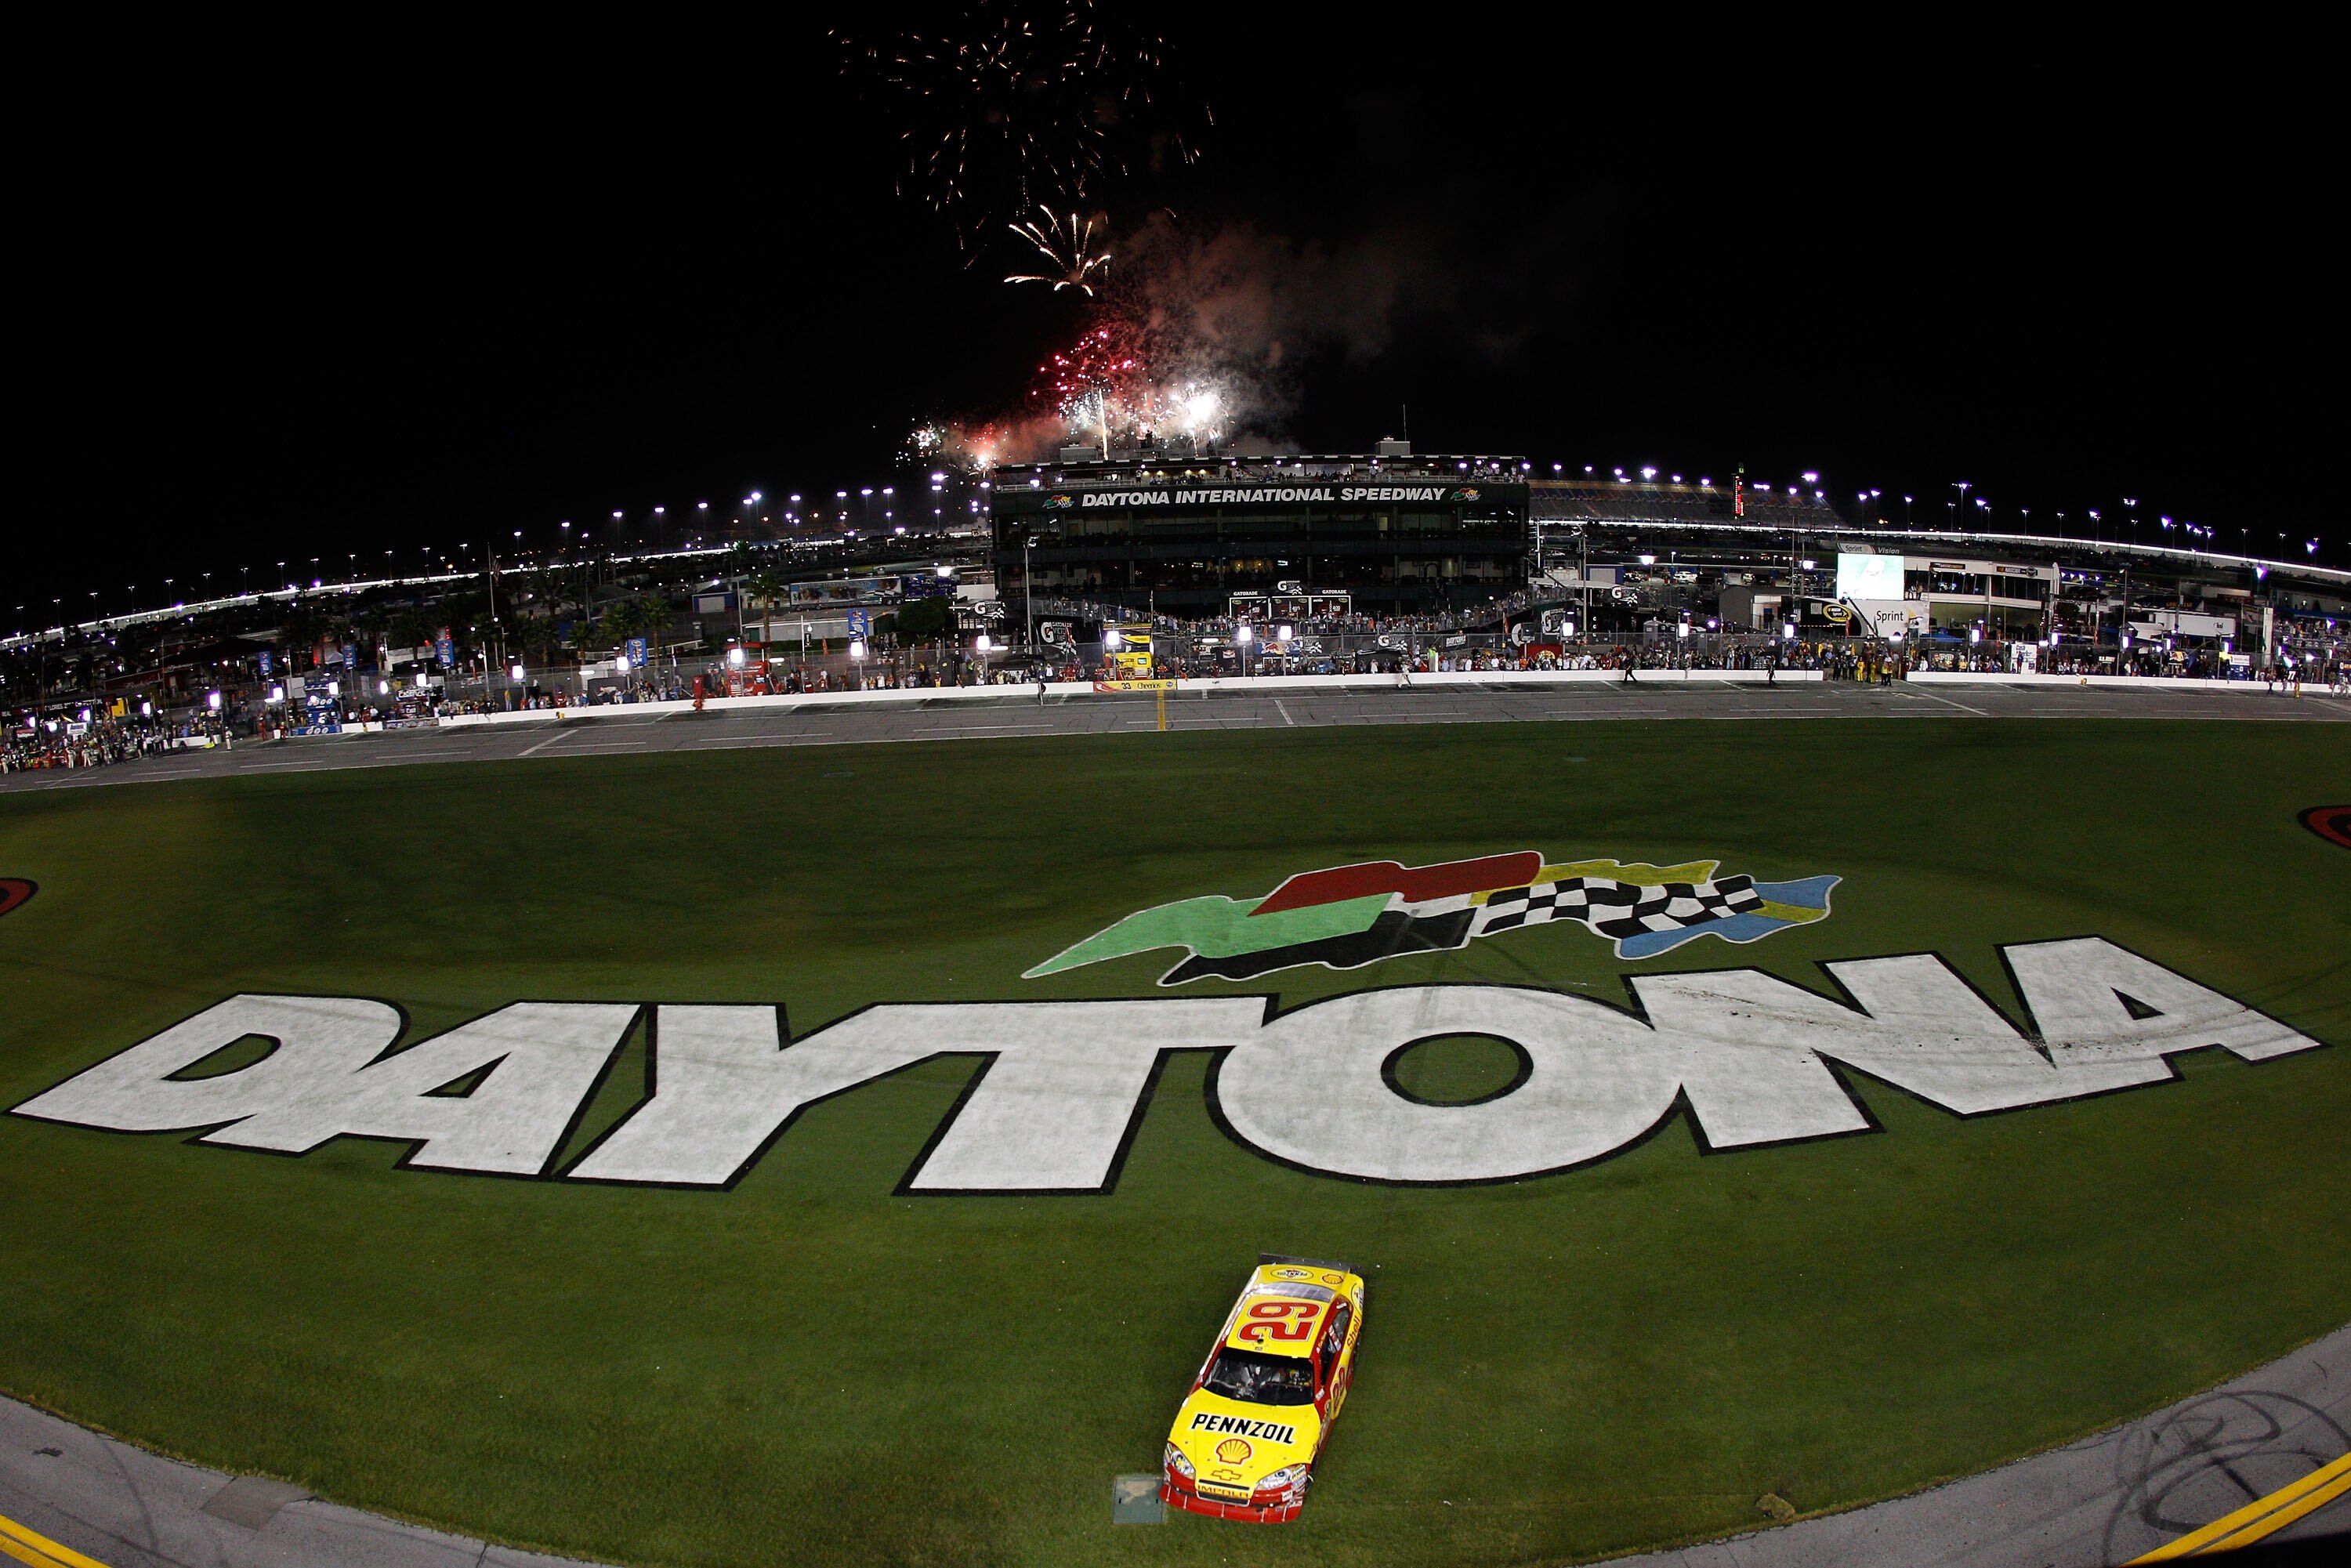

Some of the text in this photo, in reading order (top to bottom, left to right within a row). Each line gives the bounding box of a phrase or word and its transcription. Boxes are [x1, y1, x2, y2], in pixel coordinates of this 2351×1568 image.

[1082, 488, 1446, 507] DAYTONA INTERNATIONAL SPEEDWAY
[1277, 581, 1286, 591] G
[1611, 587, 1622, 599] G
[974, 603, 986, 614] G
[1876, 610, 1904, 621] Sprint
[1041, 622, 1055, 643] G
[11, 936, 2320, 1196] DAYTONA
[1238, 1301, 1322, 1342] 29
[1346, 1315, 1362, 1350] Shell
[1190, 1413, 1295, 1445] PENNZOIL
[1197, 1484, 1249, 1498] IMPALA
